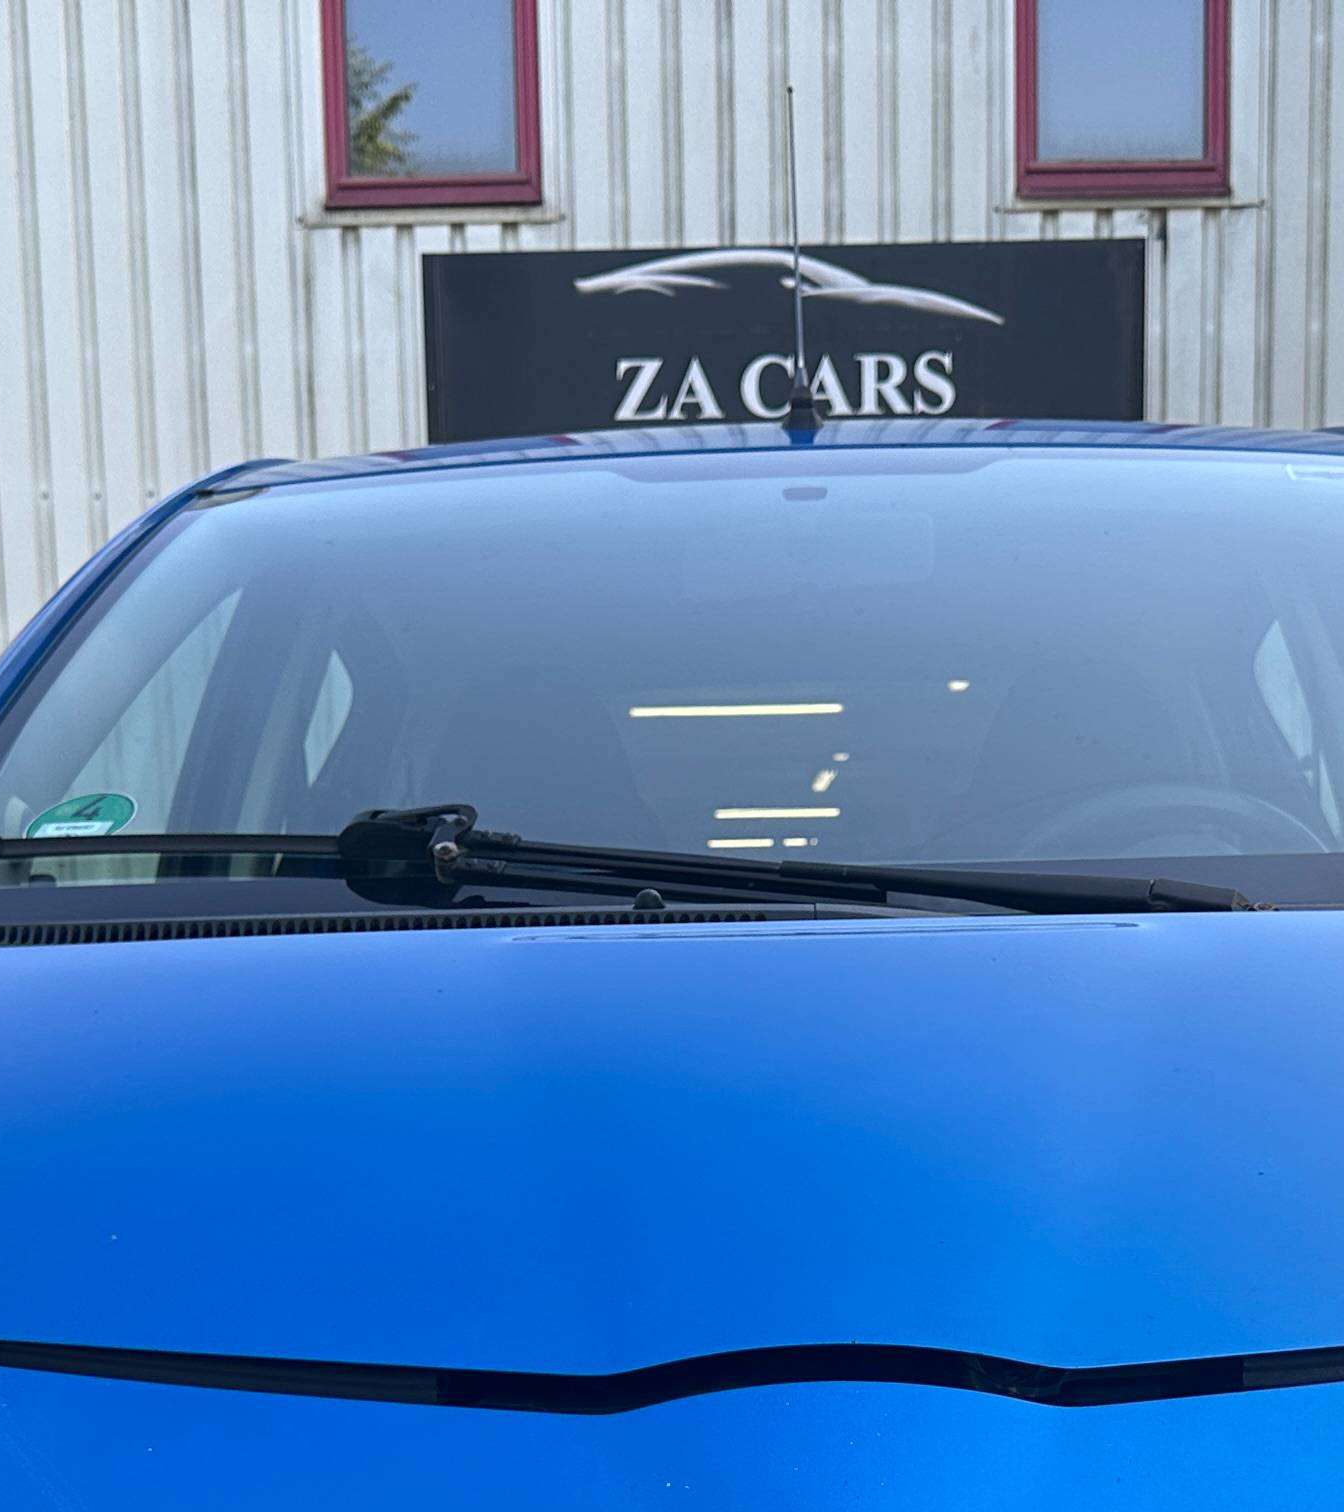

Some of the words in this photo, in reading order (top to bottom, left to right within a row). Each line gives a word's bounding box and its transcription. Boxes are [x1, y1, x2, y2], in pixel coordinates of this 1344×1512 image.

[613, 357, 726, 422] ZA
[739, 349, 957, 420] CARS
[71, 794, 106, 820] 4
